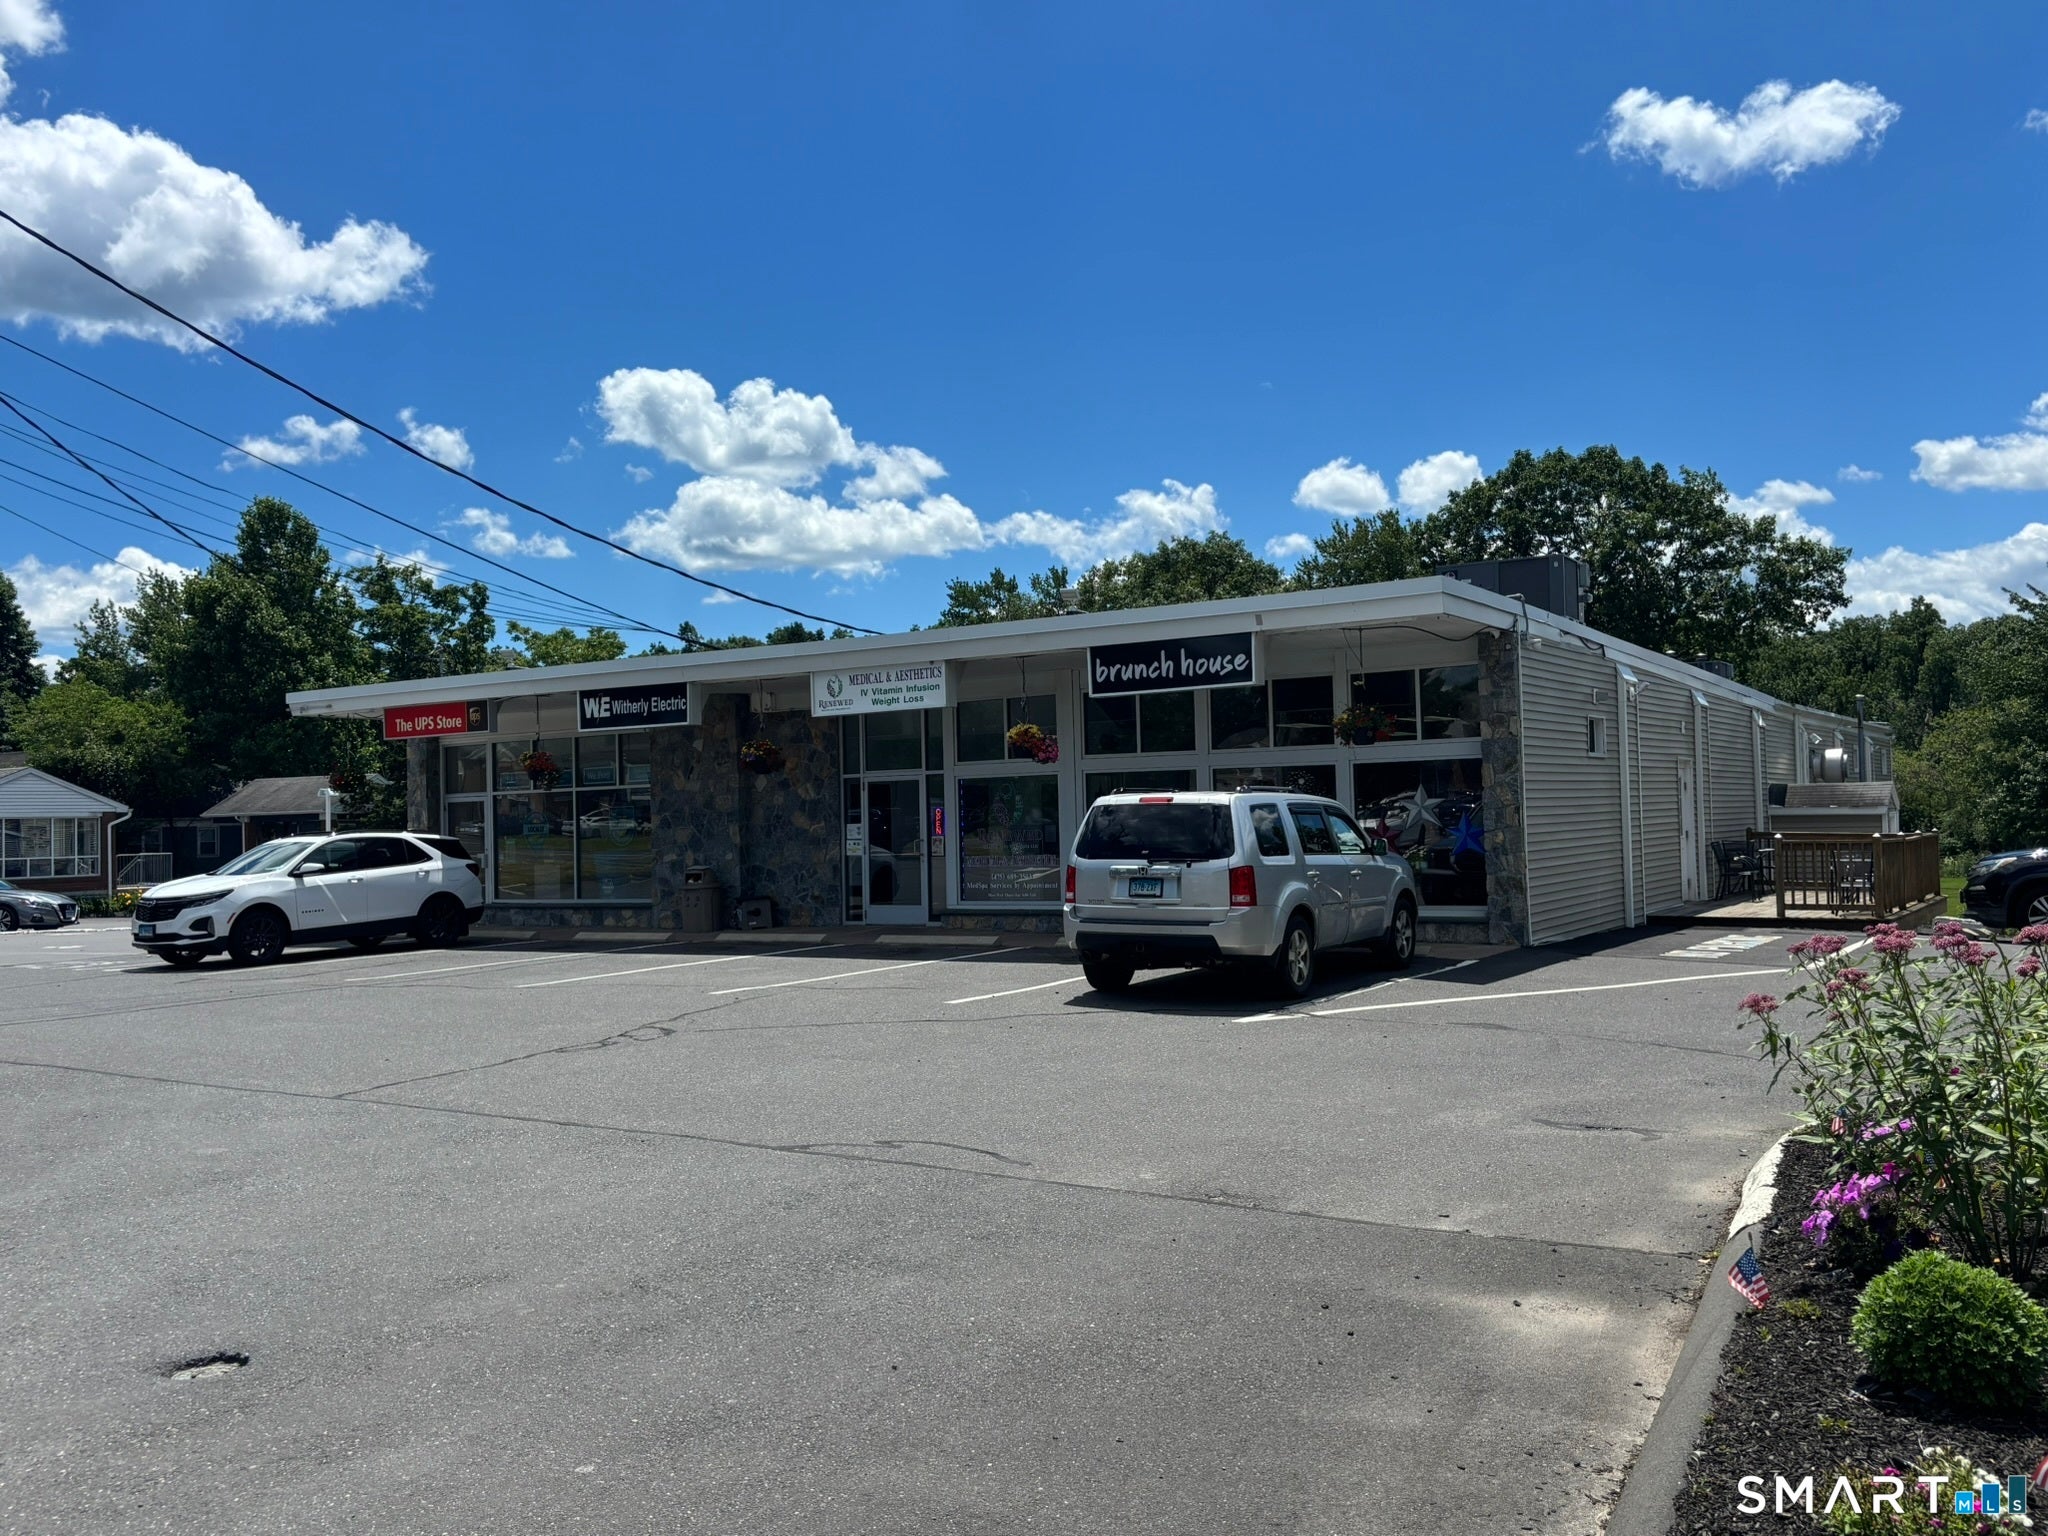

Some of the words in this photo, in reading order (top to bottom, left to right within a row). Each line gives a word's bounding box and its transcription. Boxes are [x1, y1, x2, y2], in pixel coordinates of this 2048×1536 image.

[1095, 650, 1174, 683] brunch
[1180, 648, 1250, 677] house
[848, 672, 884, 686] MEDICAL
[885, 671, 892, 682] &
[894, 664, 942, 682] AESTHETICS
[860, 689, 869, 697] IV
[871, 686, 903, 696] Vitamin
[906, 683, 940, 693] Infusion
[583, 696, 611, 719] WE
[611, 698, 649, 717] Witherly
[651, 695, 687, 712] Electric
[819, 698, 854, 709] RENEWED
[871, 696, 900, 706] Weight
[903, 695, 925, 704] Loss
[394, 719, 413, 732] The
[415, 716, 435, 730] UPS
[436, 715, 462, 729] Store
